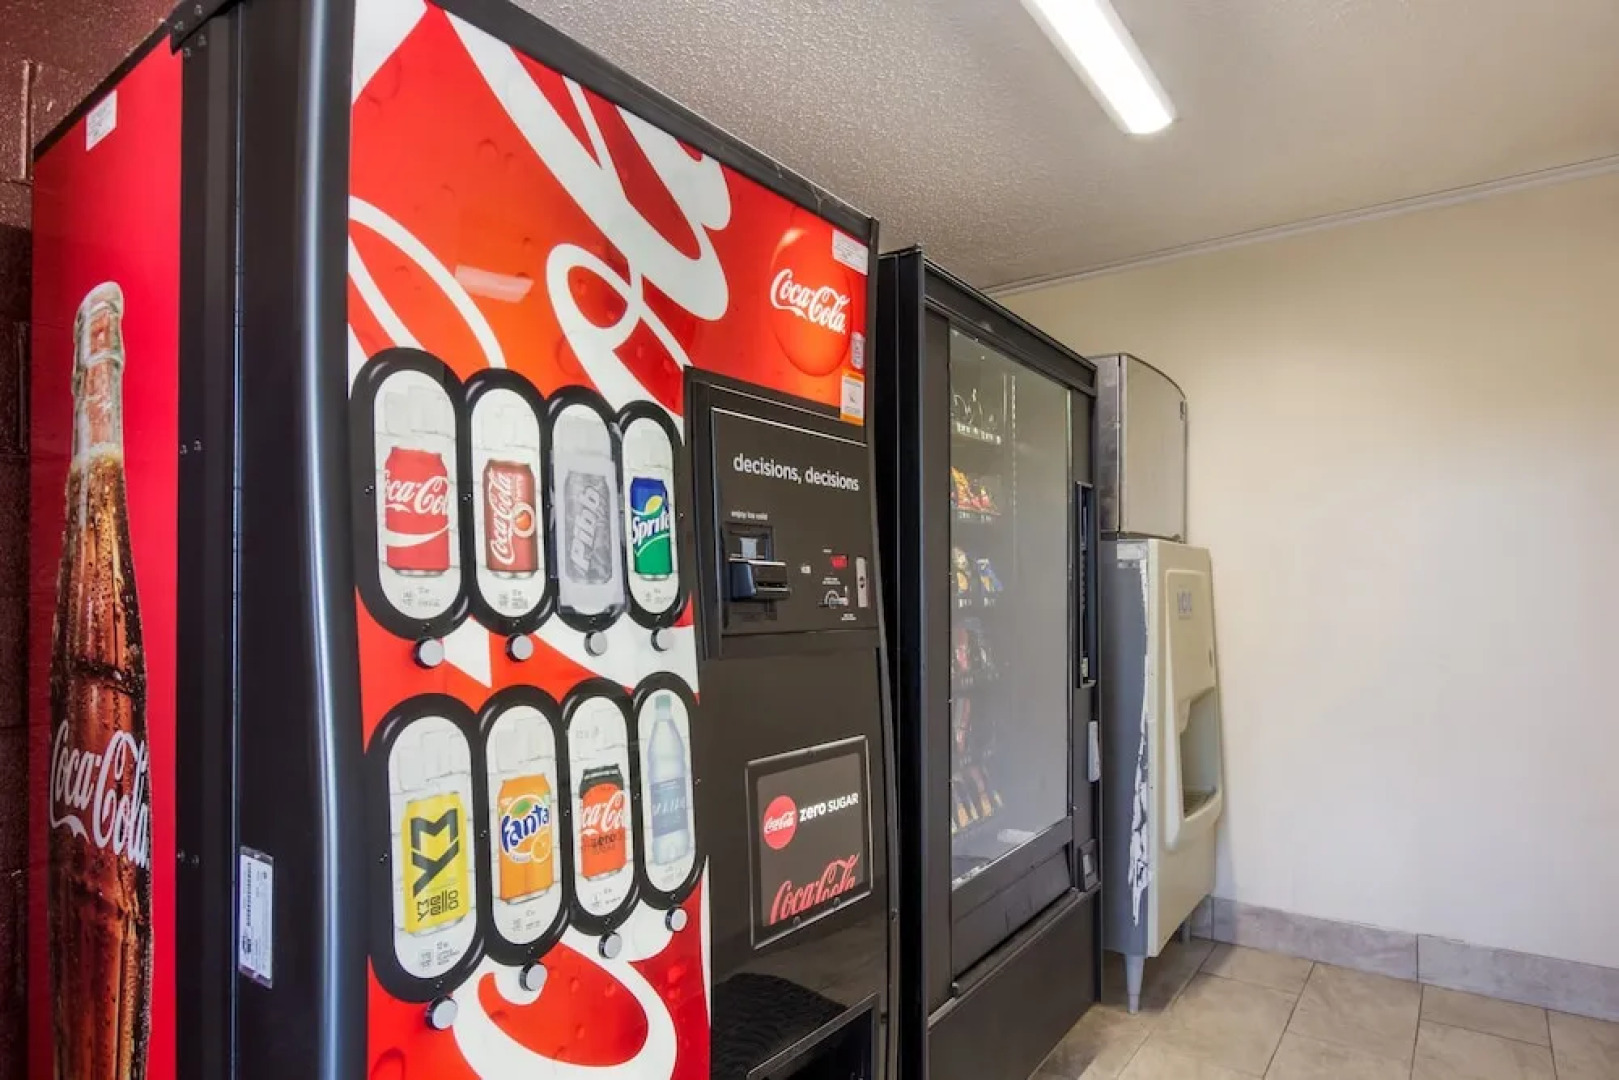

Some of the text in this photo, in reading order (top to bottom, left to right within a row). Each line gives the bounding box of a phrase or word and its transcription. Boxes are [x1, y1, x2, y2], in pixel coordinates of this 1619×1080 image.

[770, 268, 850, 334] Coca-Cola
[733, 453, 860, 491] decisions, decisions
[50, 719, 150, 870] Coca-Cola
[800, 802, 826, 822] zero
[828, 793, 859, 814] SUGAR
[770, 853, 860, 925] Coca-Cola
